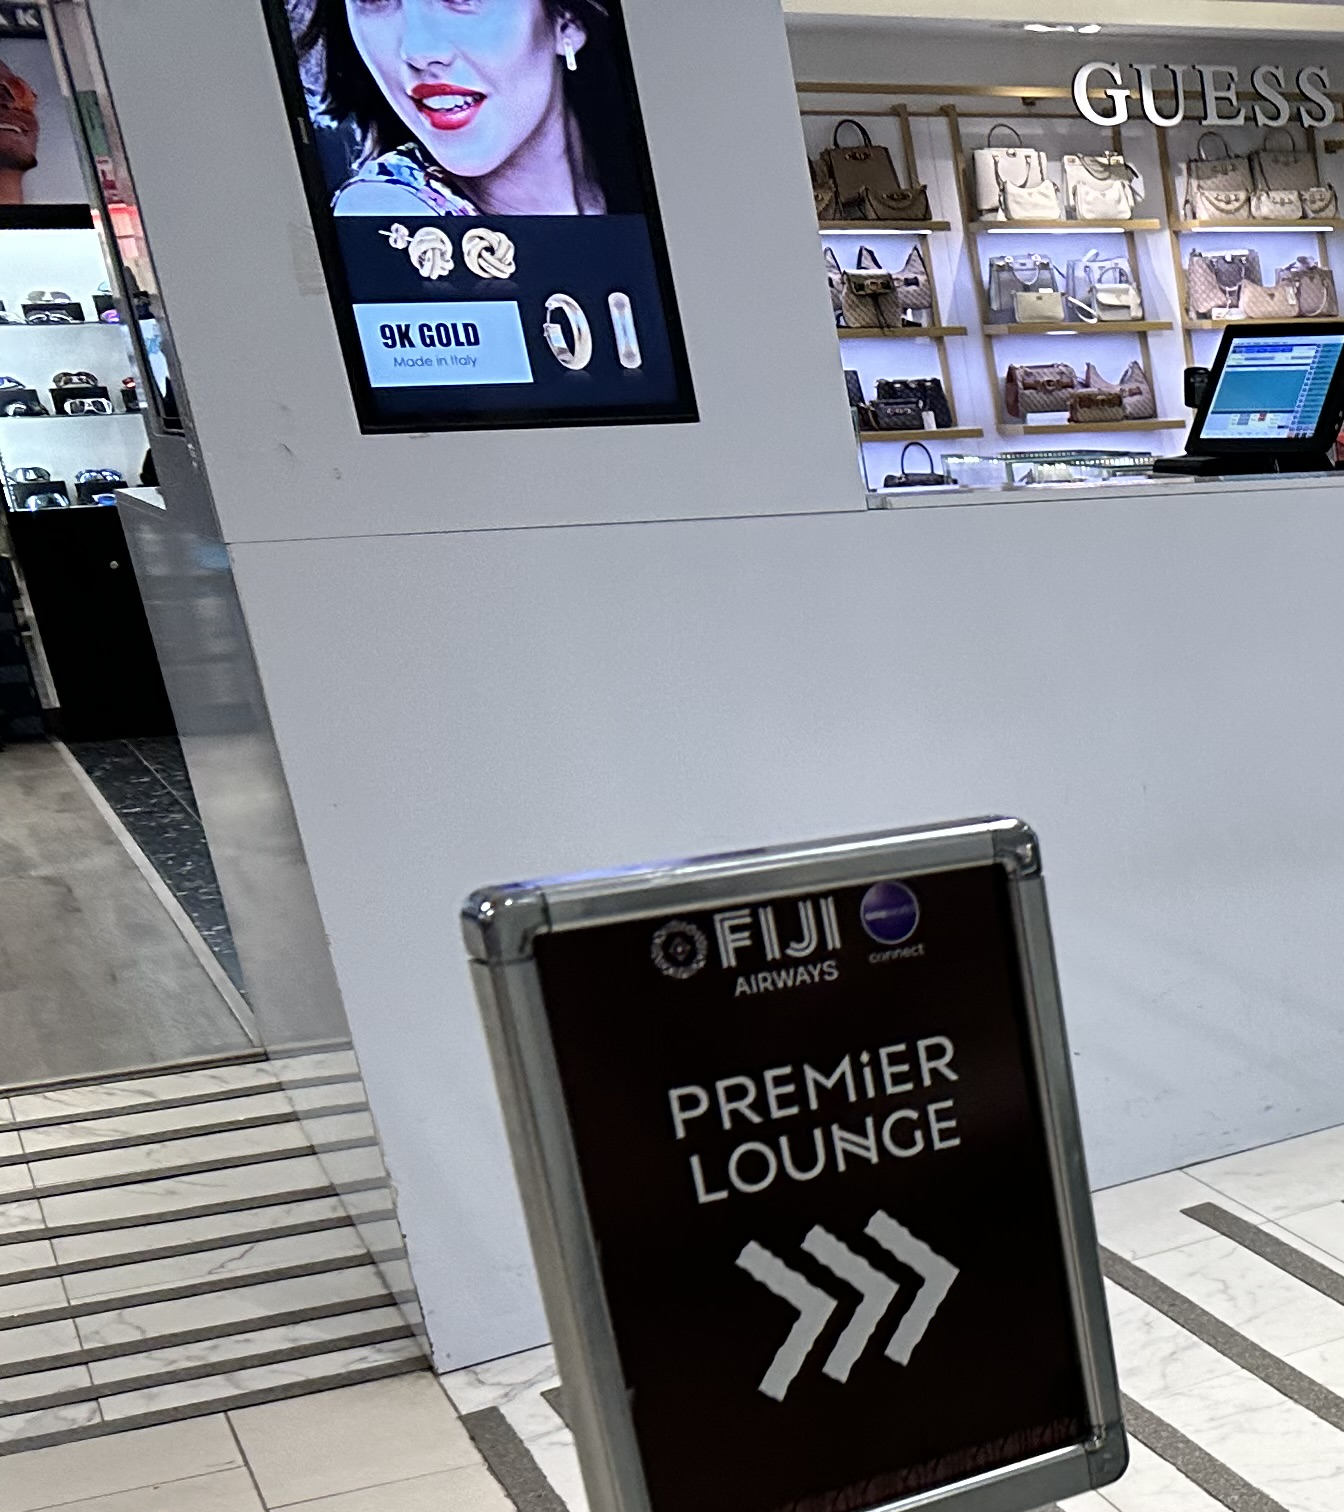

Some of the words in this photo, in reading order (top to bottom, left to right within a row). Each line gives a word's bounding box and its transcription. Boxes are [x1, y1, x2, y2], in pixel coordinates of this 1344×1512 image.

[1072, 60, 1335, 127] GUESS
[379, 323, 416, 349] 9K
[418, 322, 480, 348] GOLD
[393, 356, 433, 368] Made
[435, 354, 449, 367] in
[450, 354, 477, 368] Italy
[713, 896, 841, 969] FIJI
[734, 960, 840, 997] AIRWAYS
[689, 1099, 961, 1205] LOUNGE
